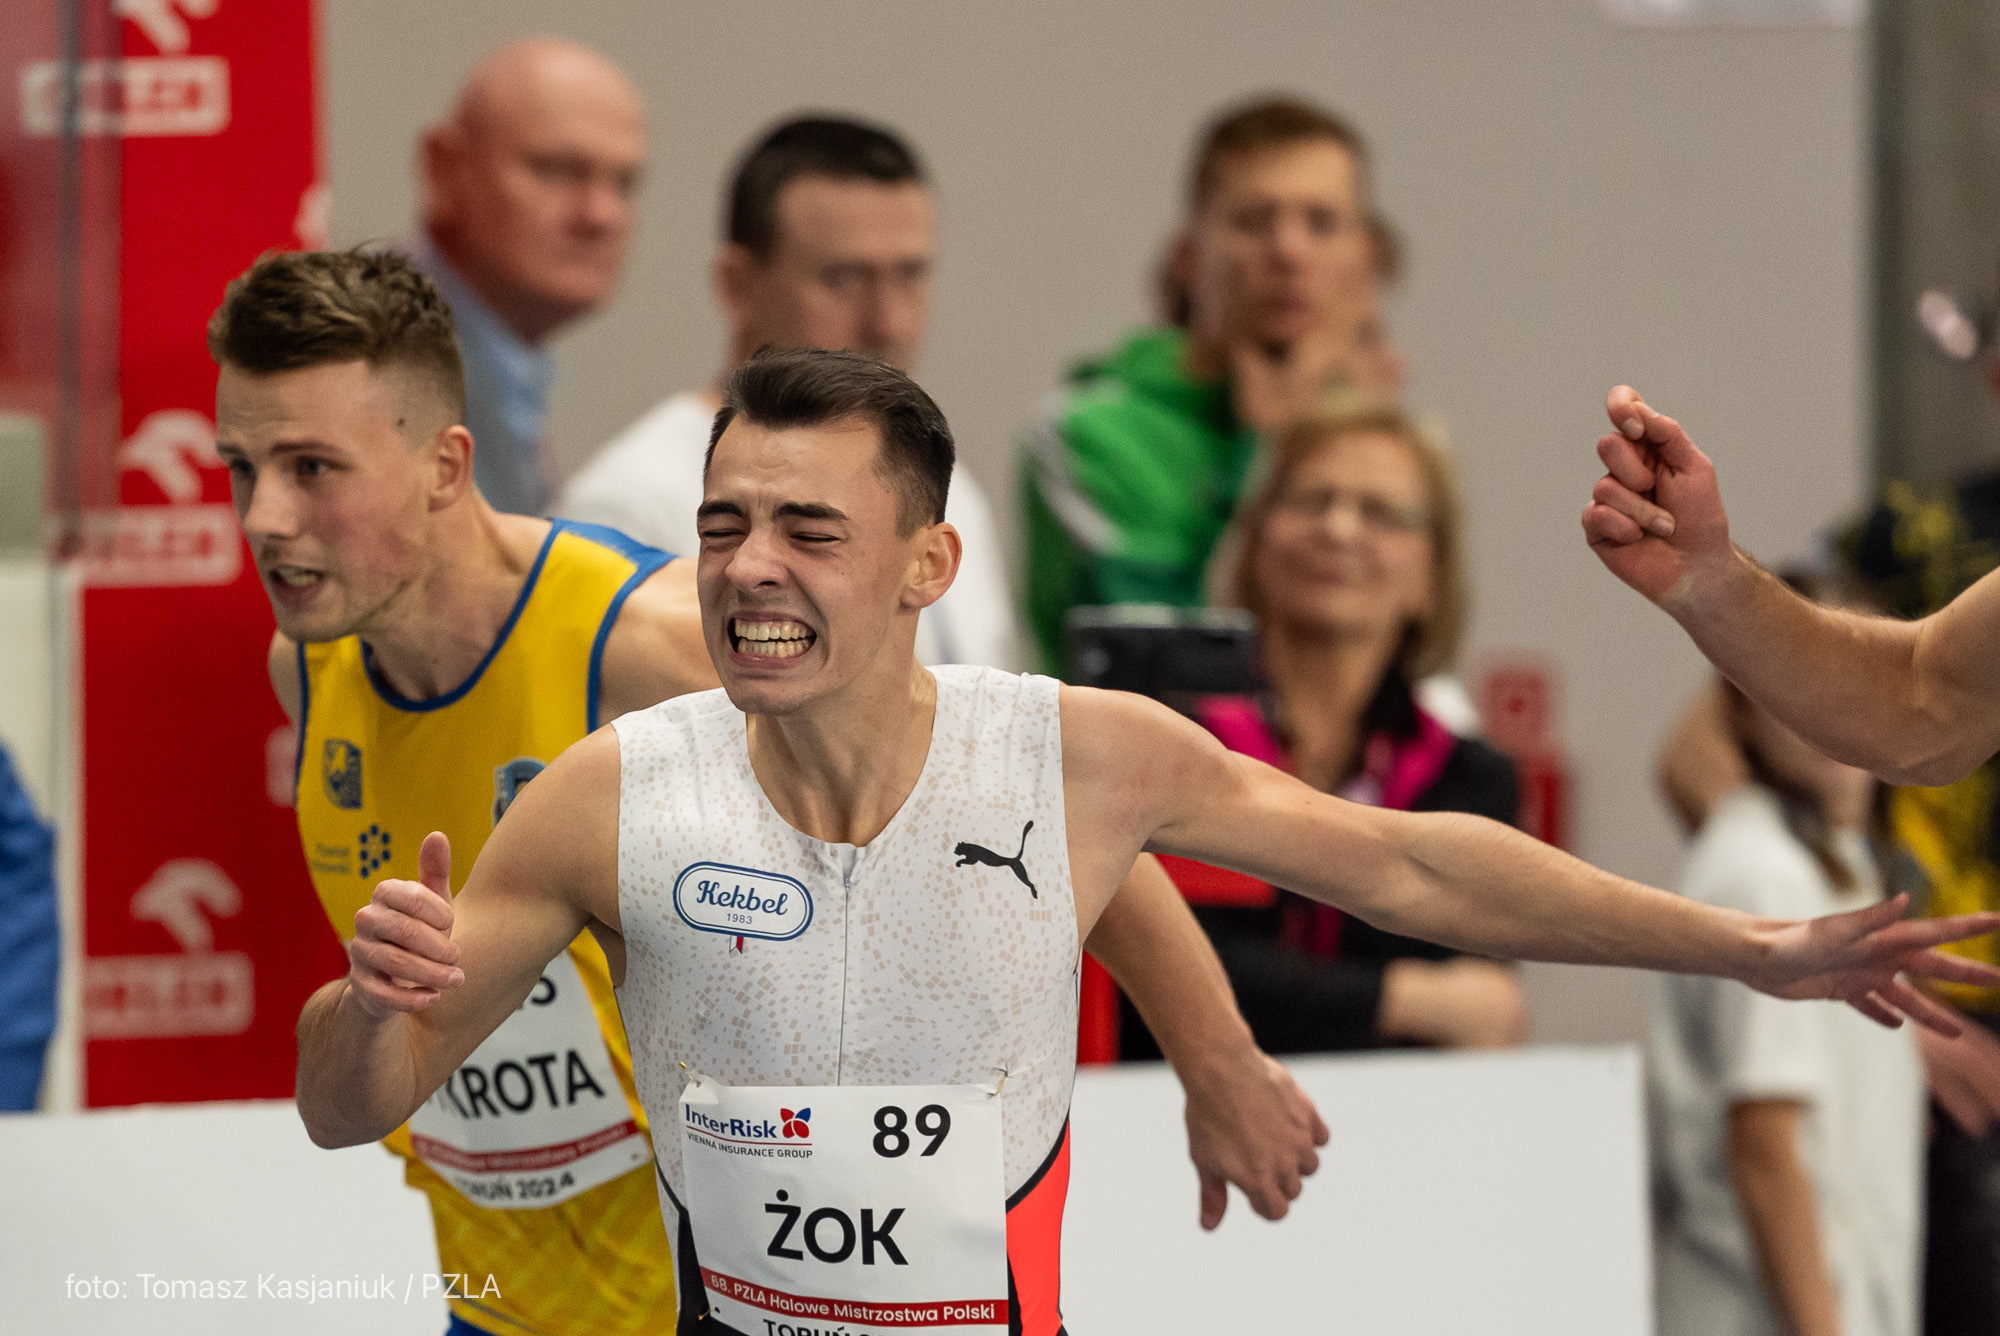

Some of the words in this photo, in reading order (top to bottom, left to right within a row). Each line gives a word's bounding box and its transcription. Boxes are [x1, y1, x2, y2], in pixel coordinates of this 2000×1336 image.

[696, 880, 788, 915] Kekbel
[726, 912, 753, 924] 1983
[685, 1103, 778, 1139] InterRisk
[872, 1104, 952, 1158] 89
[687, 1131, 717, 1149] VIENNA
[718, 1143, 774, 1157] INSURANCE
[777, 1149, 813, 1158] GROUP
[764, 1189, 909, 1266] ŻOK
[711, 1274, 731, 1292] 68.
[734, 1283, 766, 1305] PZLA
[770, 1293, 830, 1315] Halowe
[834, 1303, 938, 1323] Mistrzostwa
[943, 1303, 995, 1321] Polski
